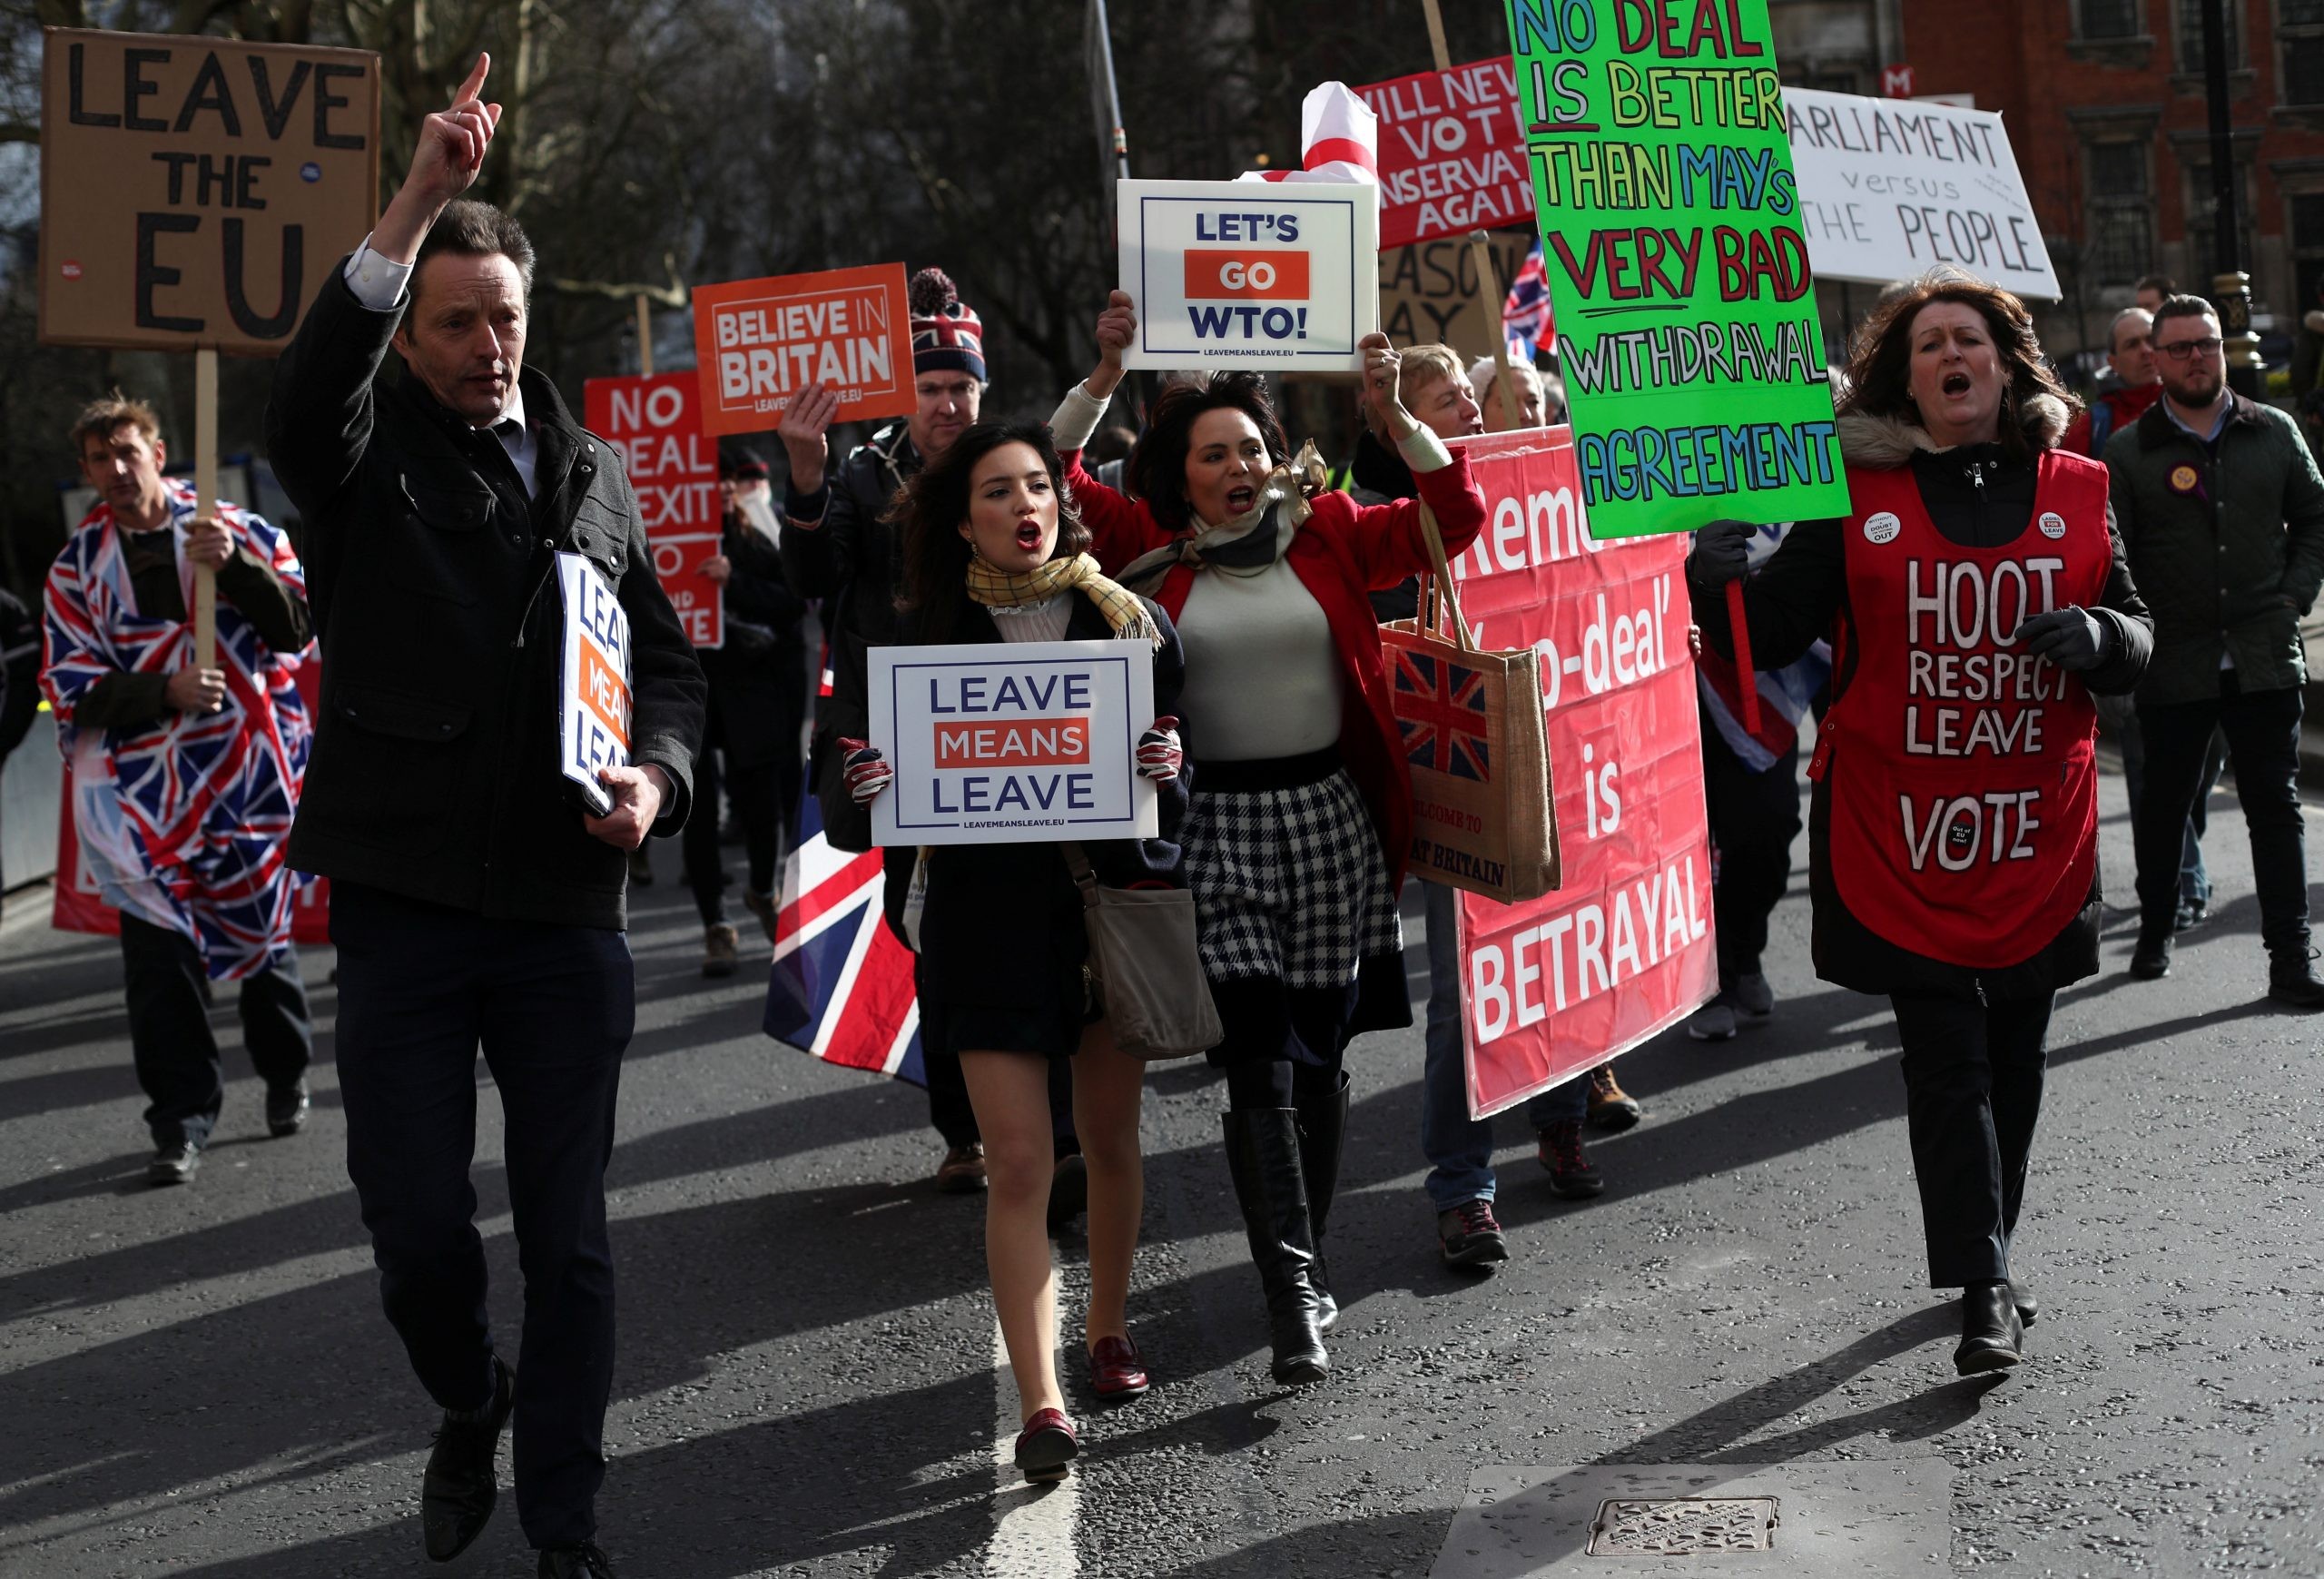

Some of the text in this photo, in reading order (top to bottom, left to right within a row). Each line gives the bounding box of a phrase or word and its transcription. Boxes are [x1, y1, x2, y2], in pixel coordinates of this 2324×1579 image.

[1514, 0, 1764, 58] NO DEAL
[70, 43, 365, 149] LEAVE
[1441, 64, 1519, 110] NEV
[1531, 60, 1787, 133] IS BETTER
[1787, 103, 1997, 168] ARLIAMENT
[152, 152, 271, 210] THE
[1531, 142, 1797, 215] THAN MAY'S
[1841, 171, 1961, 201] versus
[1196, 213, 1298, 242] LET'S
[1799, 200, 2044, 273] THE PEOPLE
[135, 212, 303, 340] EU
[1219, 261, 1276, 291] GO
[1548, 226, 1810, 302] VERY BAD
[716, 296, 886, 348] BELIEVE IN
[1187, 306, 1307, 340] WTO!
[1388, 301, 1465, 346] AY
[721, 335, 892, 399] BRITAIN
[1560, 321, 1829, 395] WITHDRAWAL
[610, 386, 684, 434] NO
[1579, 421, 1837, 506] AGREEMENT
[1870, 522, 1893, 532] DOUBT
[1874, 531, 1893, 541] OUT
[1908, 558, 2063, 650] HOOT
[589, 657, 633, 744] MEAN
[931, 674, 1091, 714] LEAVE
[940, 727, 1083, 759] MEANS
[1907, 706, 2043, 756] LEAVE
[933, 774, 1095, 814] LEAVE
[1584, 743, 1621, 839] is
[963, 818, 1065, 829] LEAVEMEANSLEAVE.EU
[1466, 814, 1482, 834] TO
[1900, 790, 2041, 871] VOTE
[1433, 843, 1506, 887] BRITAIN
[1472, 857, 1707, 1045] BETRAYAL
